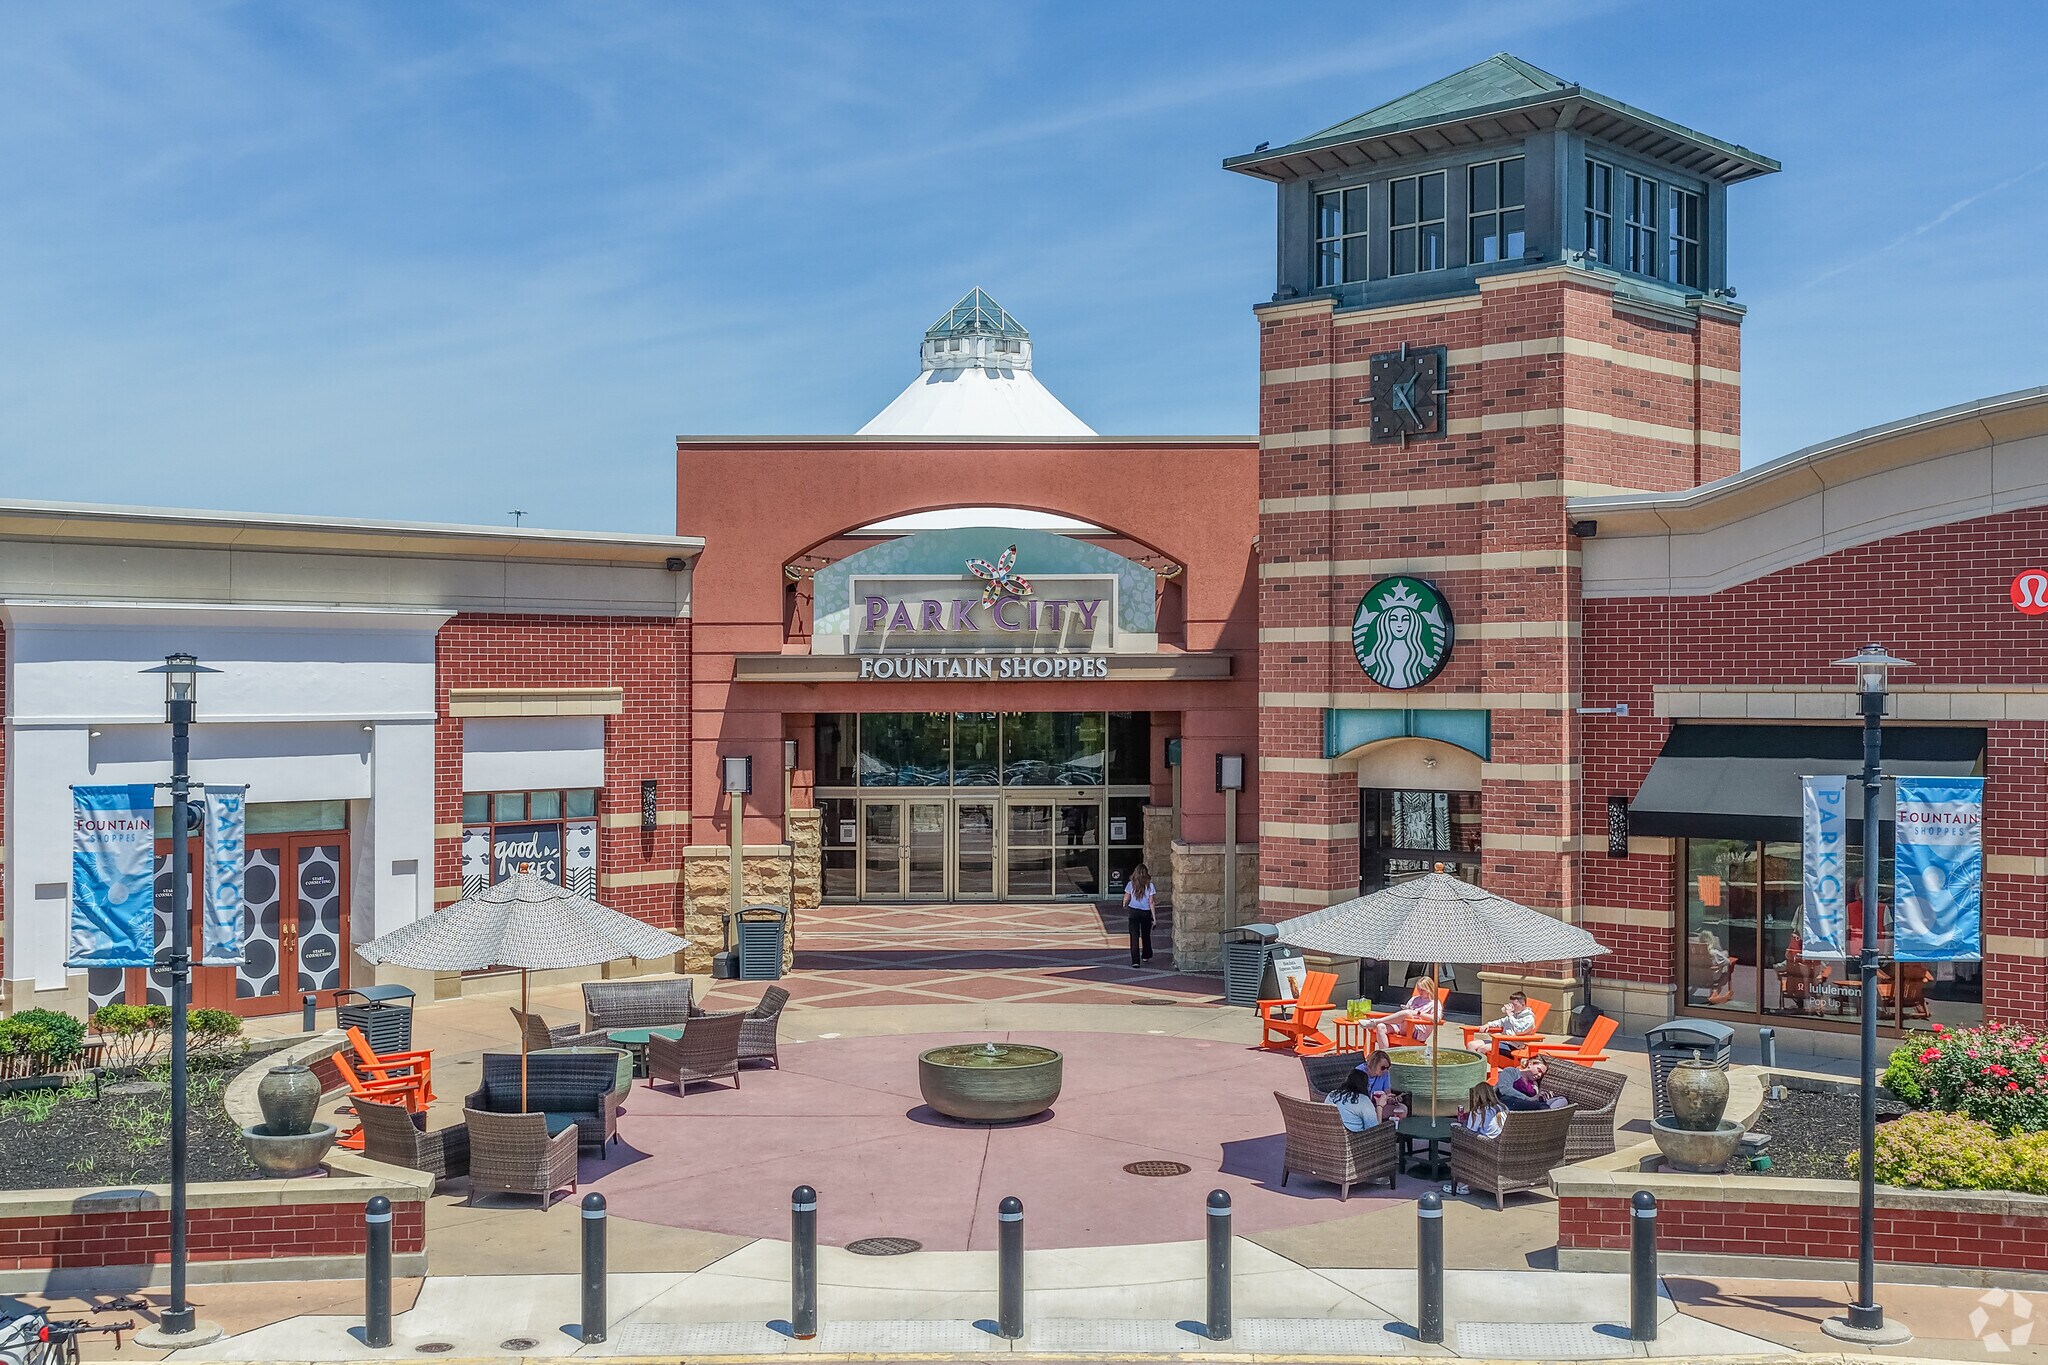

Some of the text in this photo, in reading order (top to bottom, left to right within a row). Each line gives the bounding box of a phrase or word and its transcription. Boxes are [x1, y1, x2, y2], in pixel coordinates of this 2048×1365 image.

[864, 595, 1103, 633] PARK CITY
[859, 657, 1108, 679] FOUNTAIN SHOPPES
[1900, 811, 1978, 824] FOUNTAIN
[77, 819, 151, 831] FOUNTAIN
[1914, 826, 1964, 836] SHOPPES
[90, 833, 136, 843] SHOPPES
[494, 831, 543, 876] good
[508, 859, 557, 881] VBES
[1809, 982, 1862, 997] lululemon
[1809, 996, 1841, 1009] Pop Up
